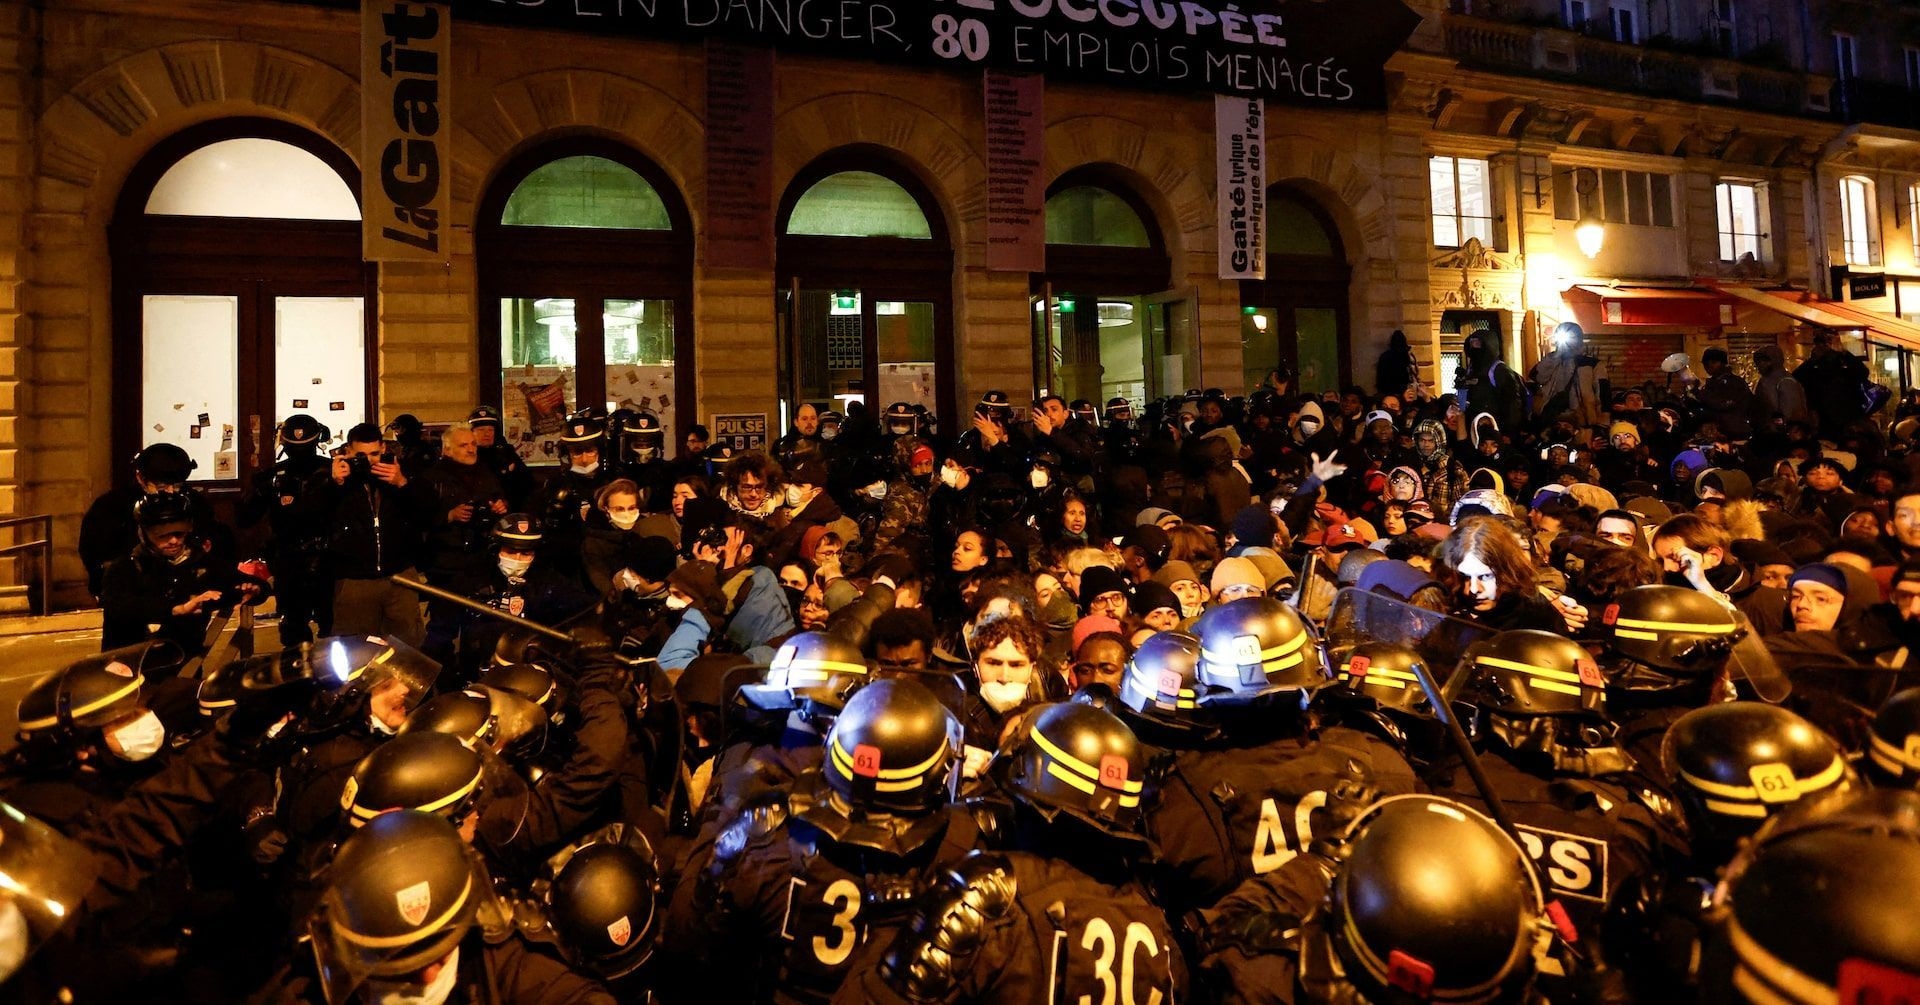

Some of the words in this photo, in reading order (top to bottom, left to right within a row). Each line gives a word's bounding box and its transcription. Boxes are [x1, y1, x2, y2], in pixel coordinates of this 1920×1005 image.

[684, 0, 913, 51] DANGER,
[932, 14, 990, 61] 80
[1206, 50, 1353, 101] MENACÉS
[1229, 133, 1248, 184] Lyrique
[1248, 144, 1261, 172] de
[1230, 187, 1248, 273] Gaîté
[1250, 175, 1264, 273] Fabrique
[717, 419, 764, 434] PULSE
[1352, 659, 1365, 673] 61
[1583, 666, 1600, 681] 61
[1161, 676, 1177, 689] 61
[856, 754, 875, 769] 61
[1105, 763, 1123, 781] 61
[1761, 773, 1789, 792] 61
[1079, 917, 1163, 1005] 3C
